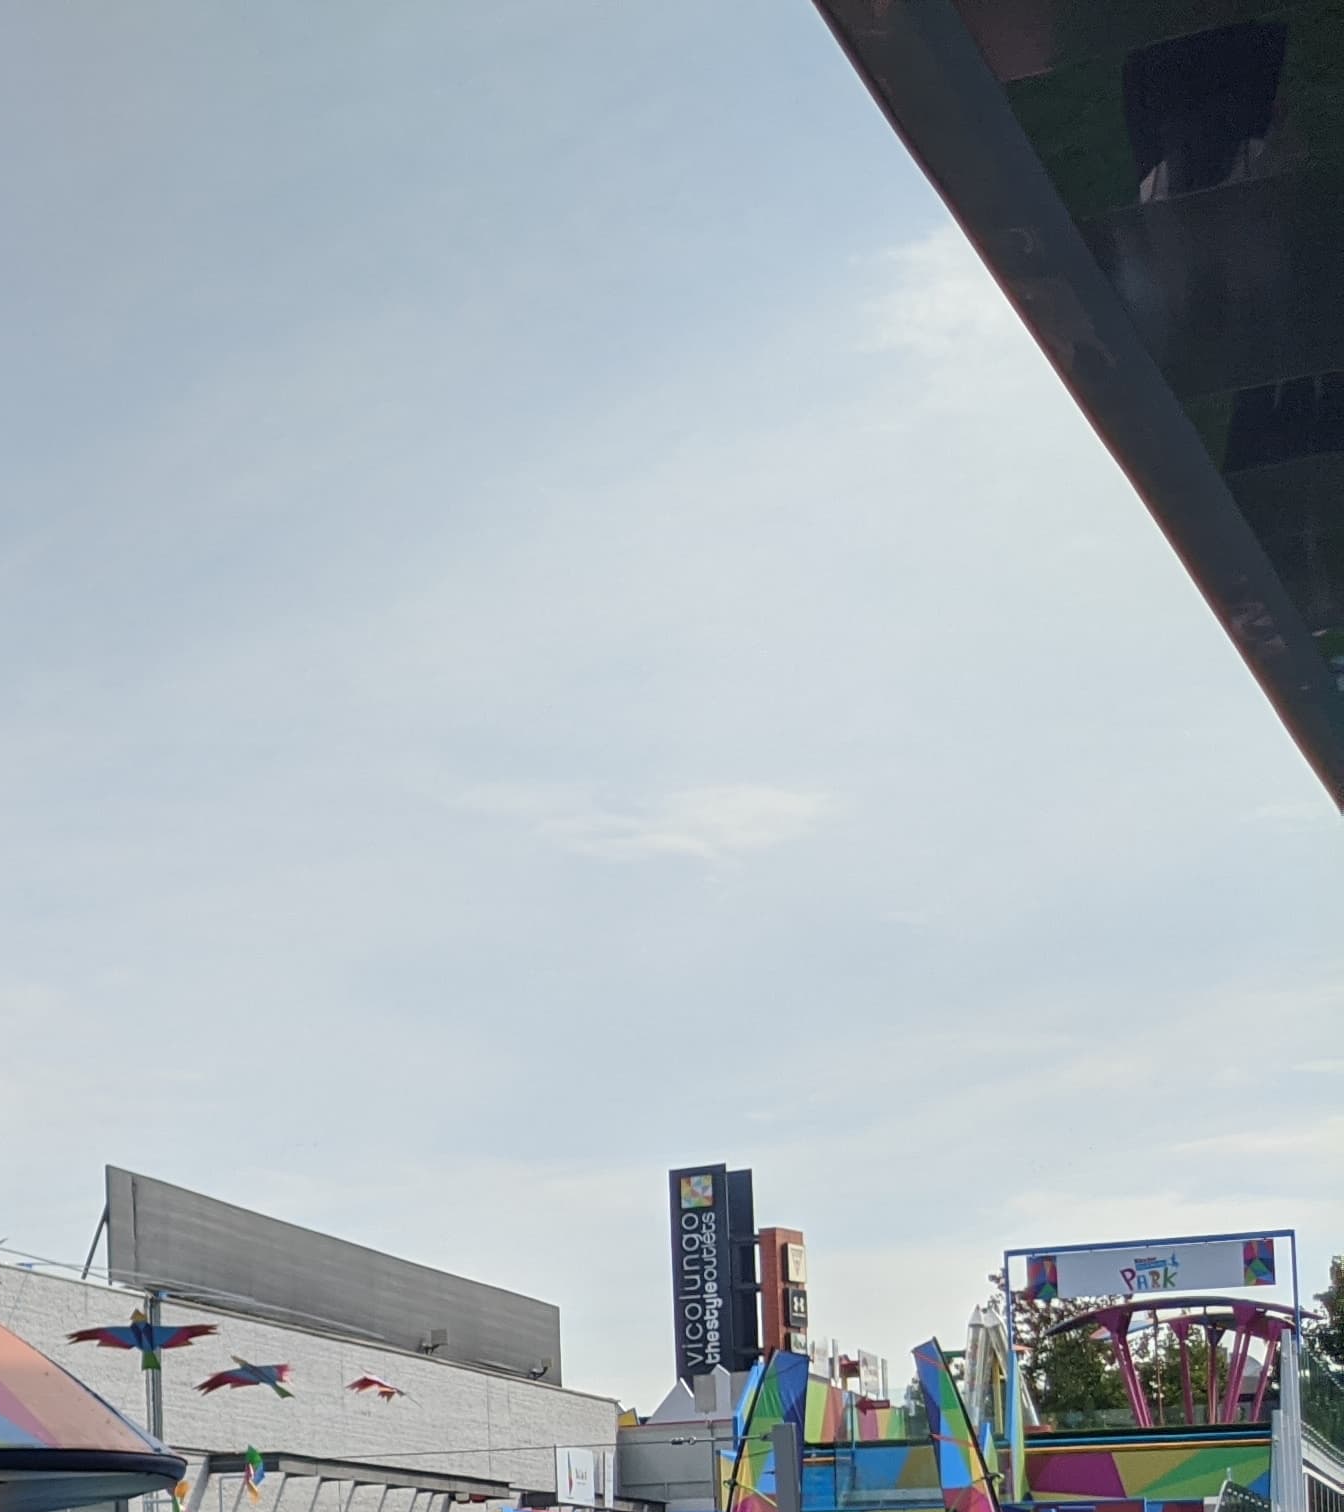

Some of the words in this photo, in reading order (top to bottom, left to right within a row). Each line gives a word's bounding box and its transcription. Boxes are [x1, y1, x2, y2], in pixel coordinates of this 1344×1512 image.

[679, 1212, 704, 1367] vicolungo
[702, 1211, 723, 1364] thestyleoutlets
[1120, 1267, 1178, 1291] PARK
